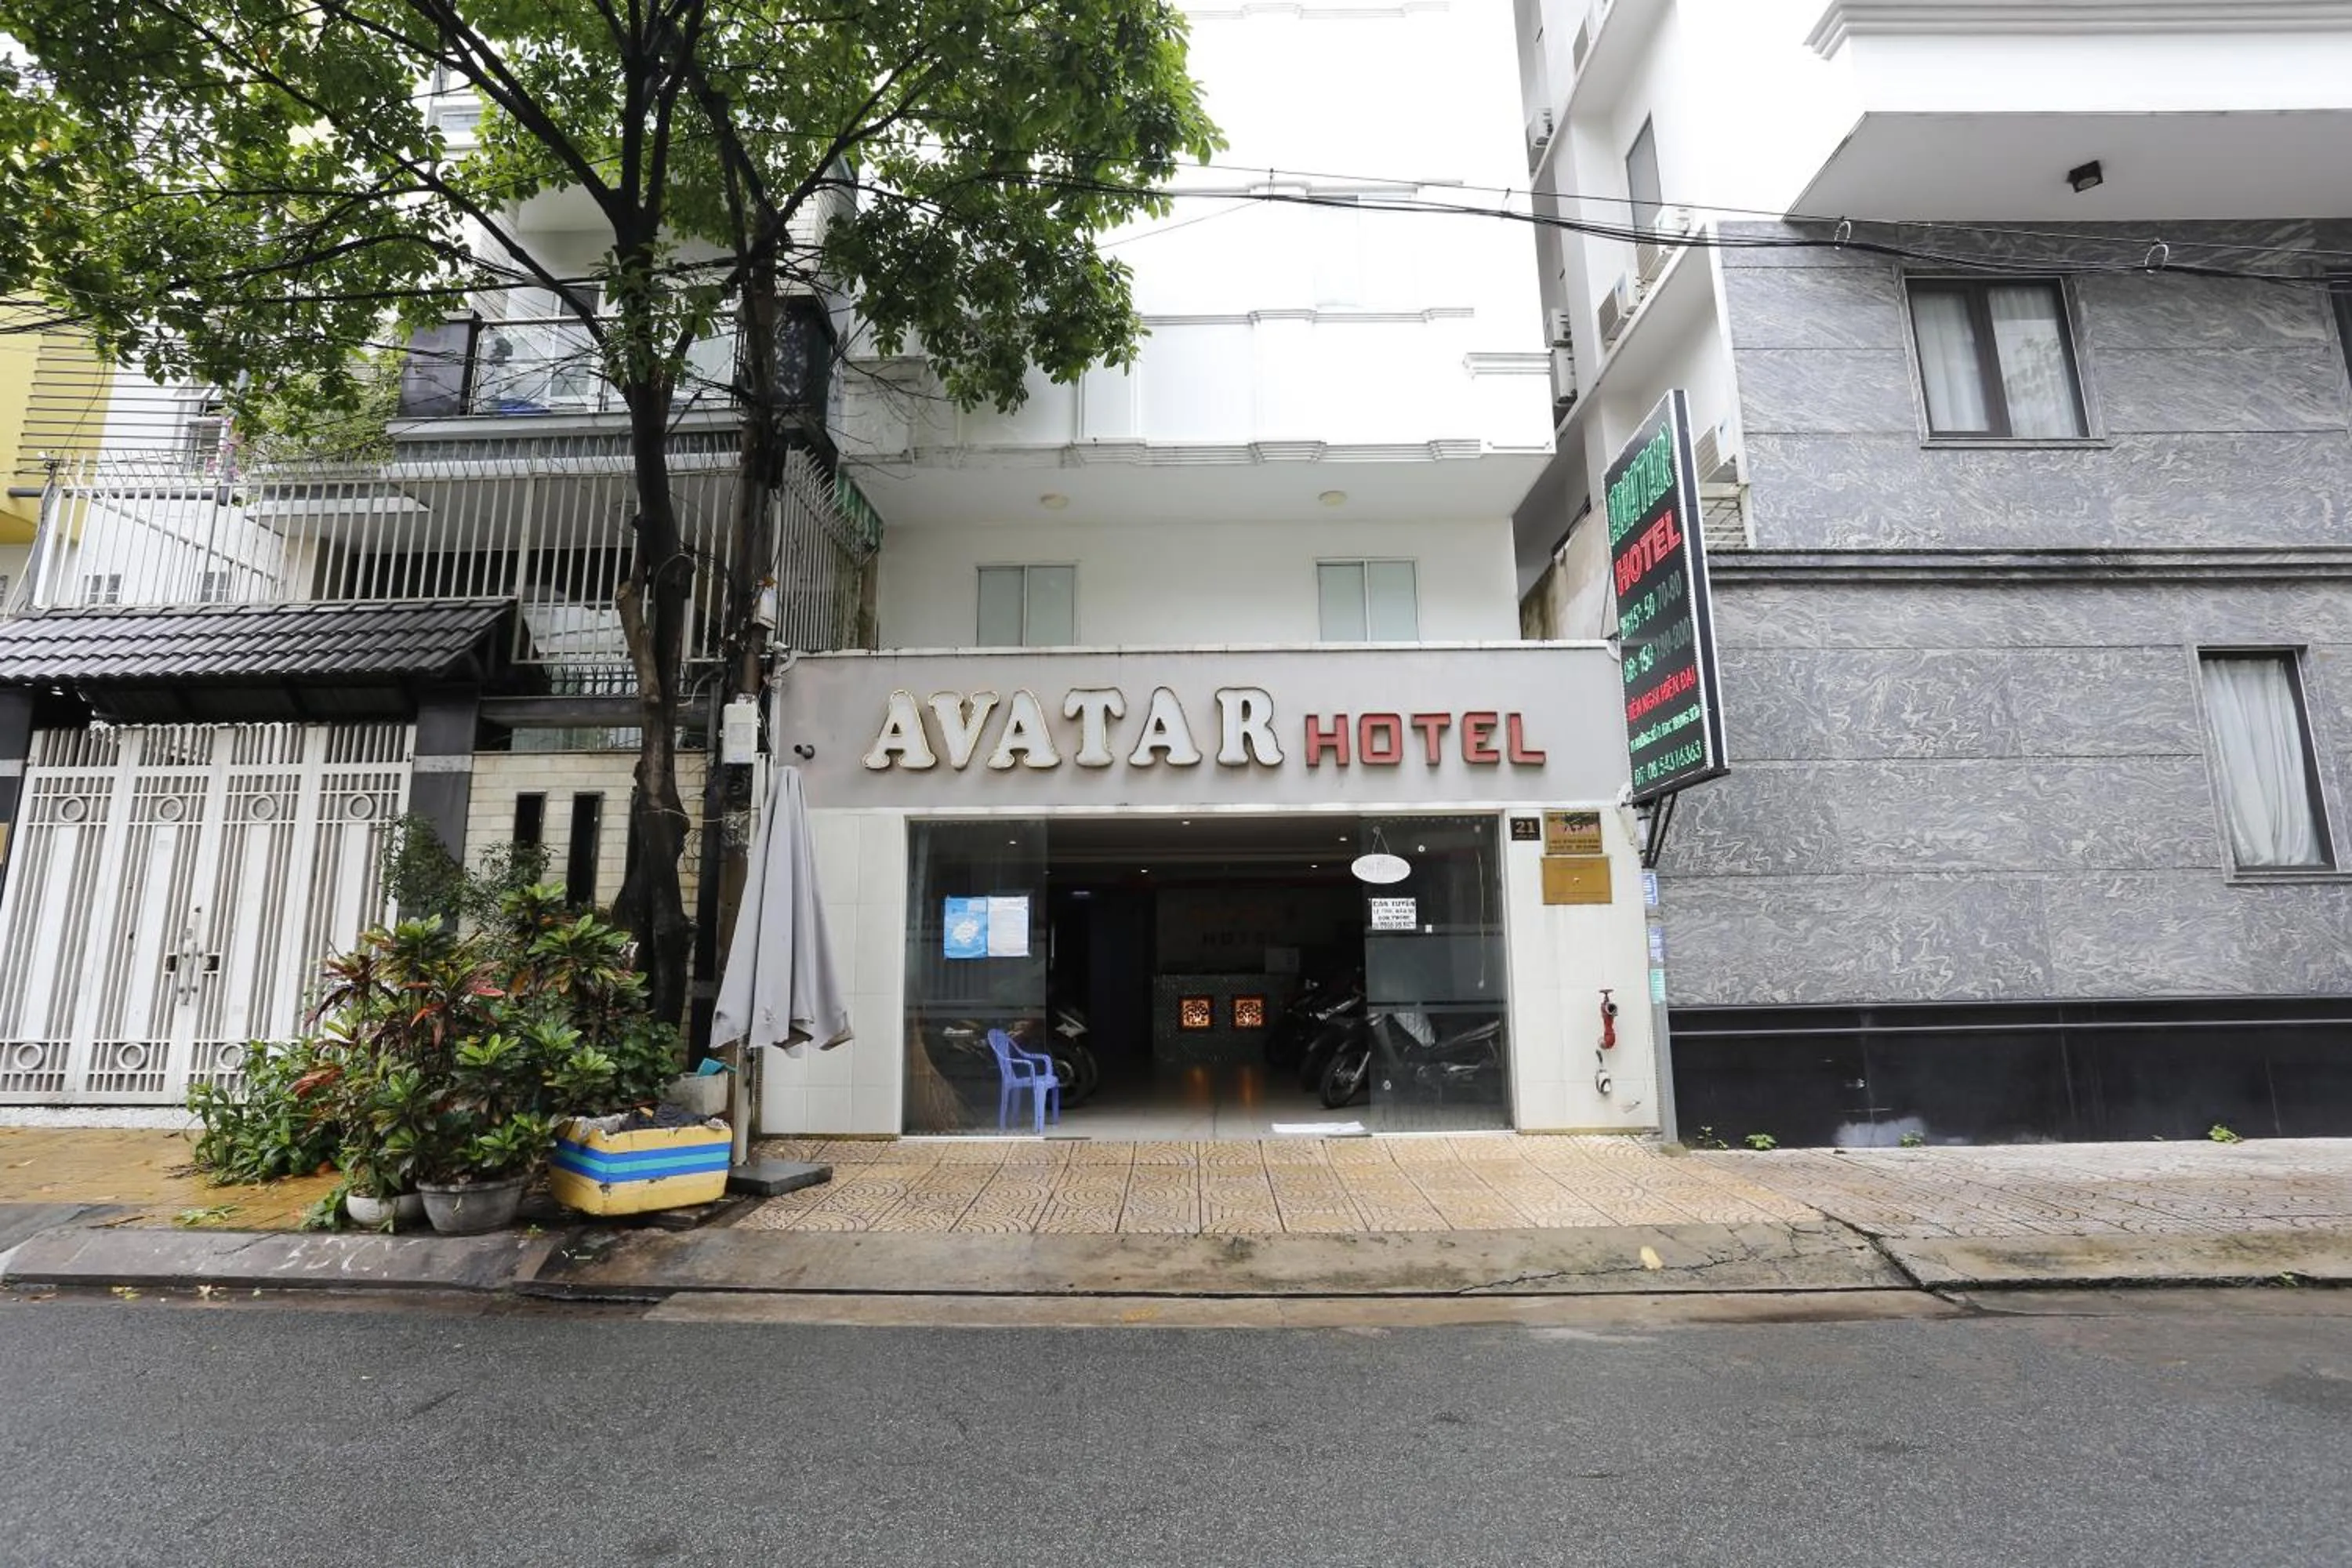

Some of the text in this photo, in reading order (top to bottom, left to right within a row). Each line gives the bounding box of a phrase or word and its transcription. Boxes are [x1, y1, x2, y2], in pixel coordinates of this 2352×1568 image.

[1614, 510, 1682, 597] HOTEL
[862, 687, 1547, 769] AVATAR HOTEL
[1515, 820, 1536, 833] 21
